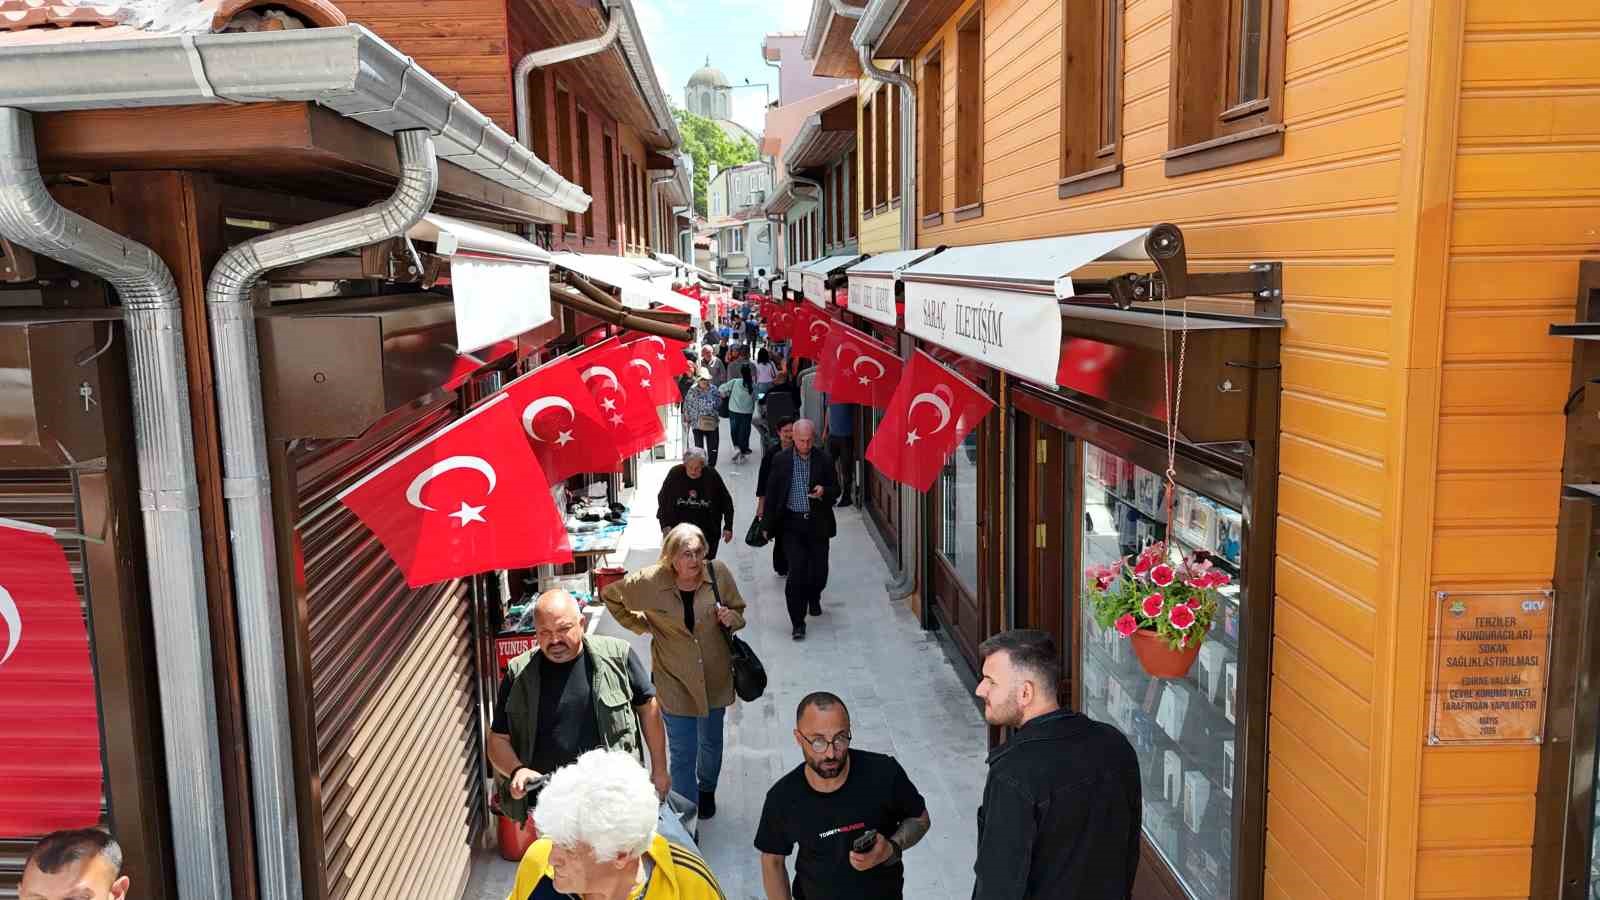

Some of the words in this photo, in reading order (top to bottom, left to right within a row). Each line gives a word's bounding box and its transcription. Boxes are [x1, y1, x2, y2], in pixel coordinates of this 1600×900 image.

[923, 299, 946, 340] SARAÇ
[955, 298, 1004, 354] İLETİŞİM
[1475, 615, 1517, 627] TERZİLER
[498, 640, 529, 656] YUNUS
[1479, 643, 1508, 654] SOKAK
